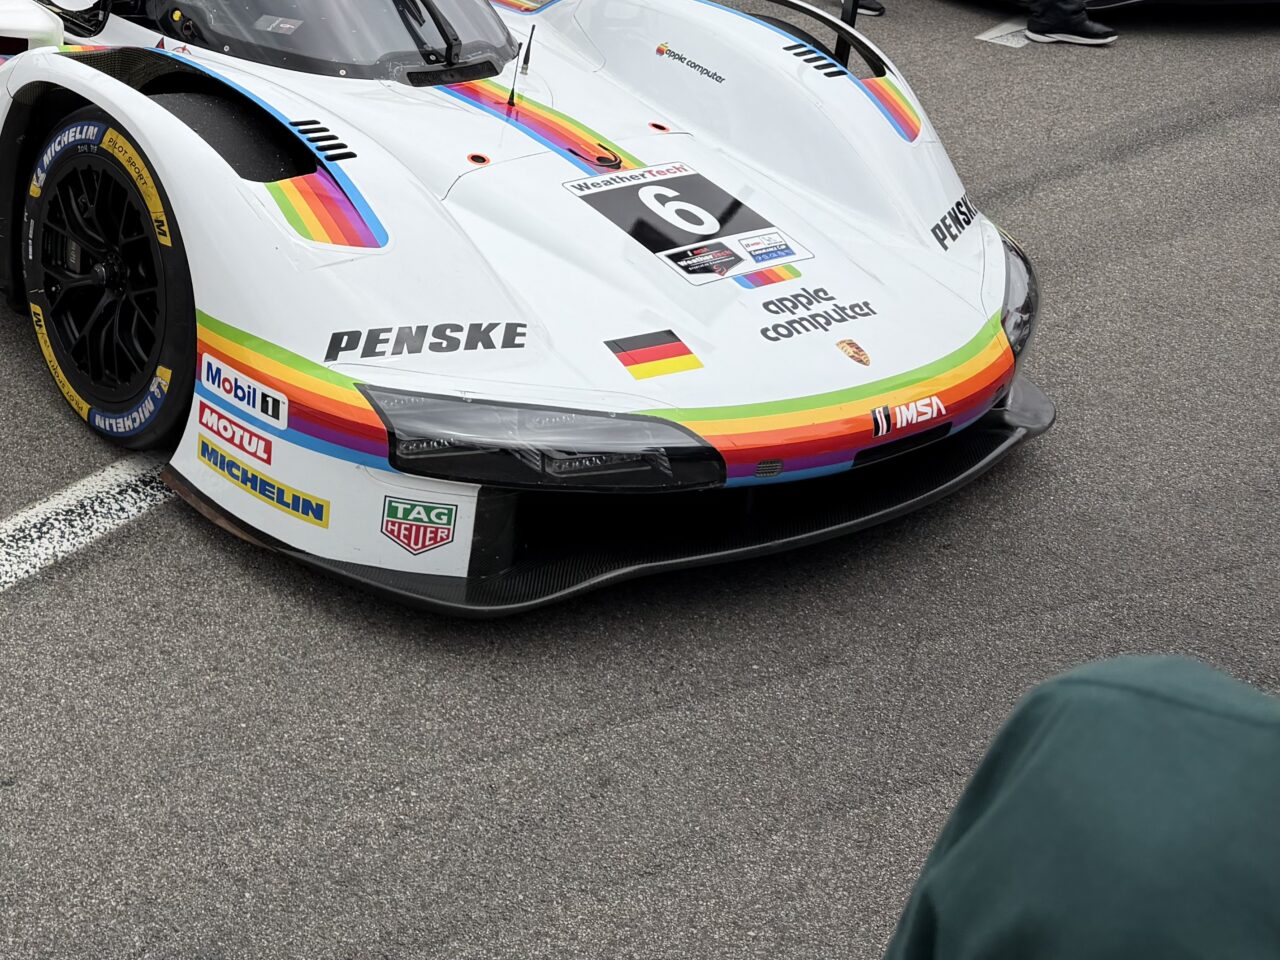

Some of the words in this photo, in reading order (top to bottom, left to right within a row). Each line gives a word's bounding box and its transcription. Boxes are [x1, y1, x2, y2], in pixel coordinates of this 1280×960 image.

[665, 48, 687, 64] apple
[686, 59, 726, 84] computer
[43, 125, 99, 169] MICHELIN
[108, 137, 128, 157] PILOT
[126, 156, 148, 187] SPORT
[571, 164, 689, 193] WeatherTech
[638, 184, 721, 236] 6
[930, 194, 979, 252] PENSK
[760, 301, 877, 342] computer
[762, 287, 837, 316] apple
[324, 321, 528, 363] PENSKE
[206, 361, 257, 410] Mobil
[261, 393, 280, 420] 1
[94, 396, 155, 433] MICHELIN
[894, 395, 947, 429] IMSA
[200, 408, 270, 460] MOTUL
[200, 440, 325, 522] MICHELIN
[391, 502, 448, 524] TAG
[387, 521, 449, 550] HEUER
